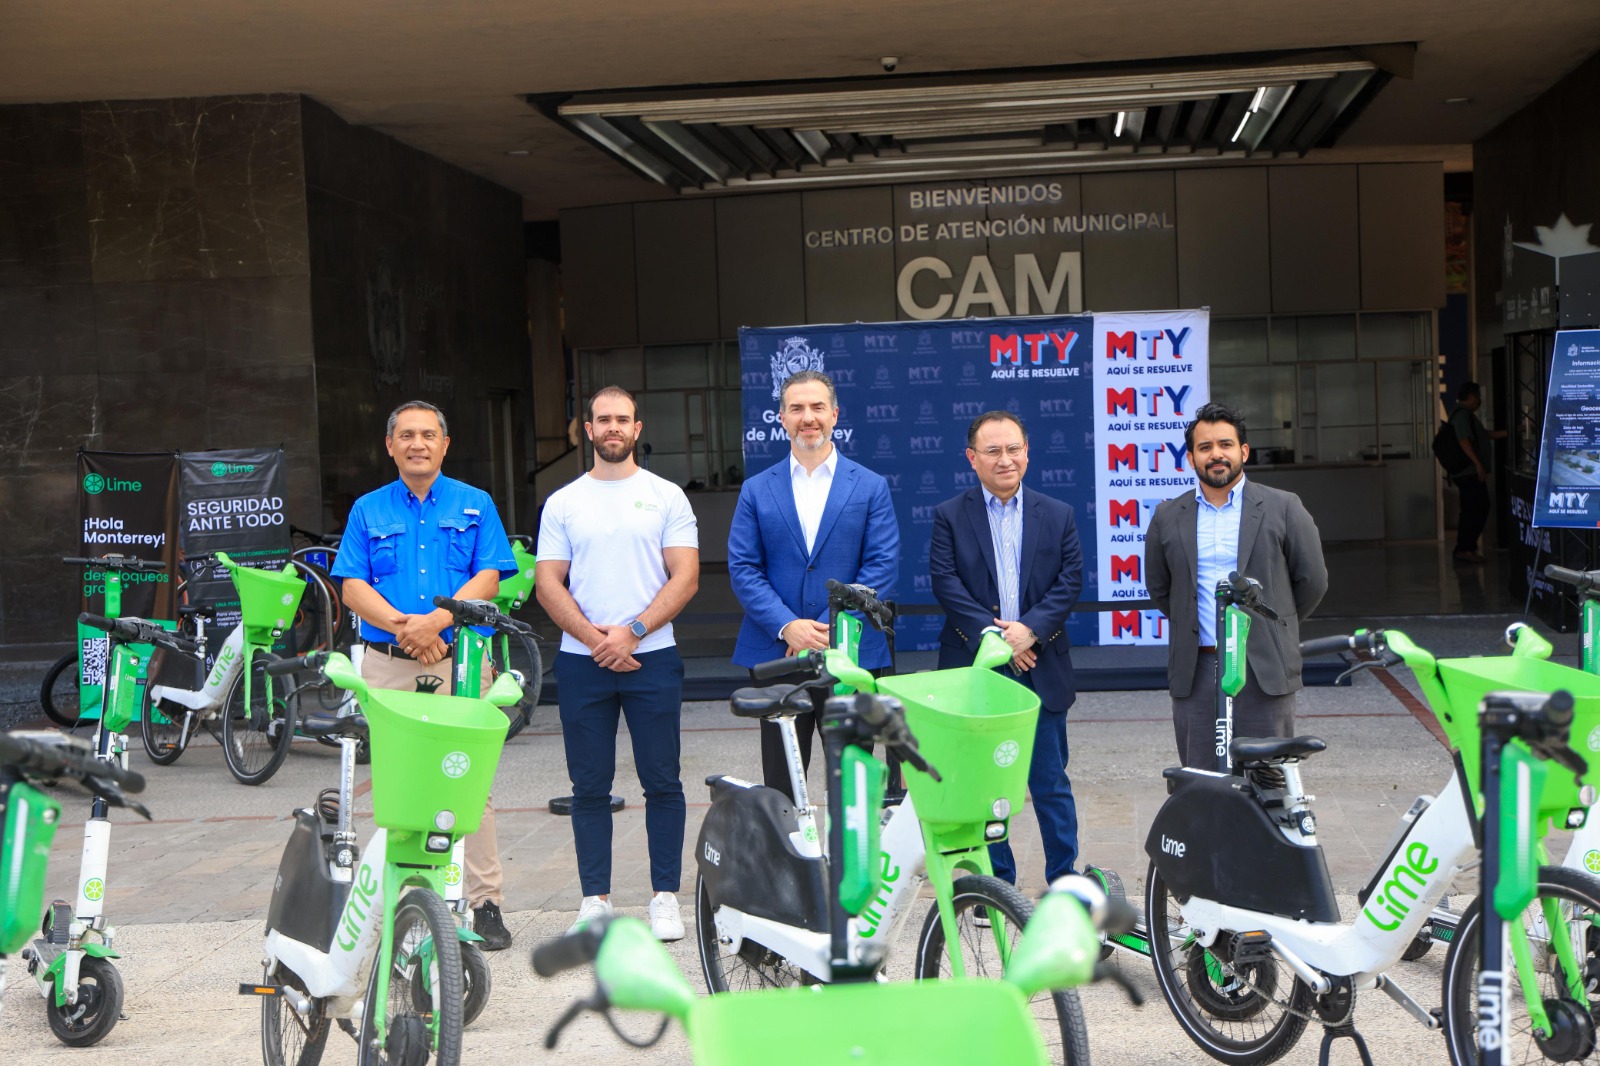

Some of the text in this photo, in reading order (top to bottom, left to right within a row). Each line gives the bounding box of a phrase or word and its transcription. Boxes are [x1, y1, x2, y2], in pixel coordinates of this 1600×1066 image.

[909, 183, 1063, 209] BIENVENIDOS
[805, 212, 1174, 248] CENTRO DE ATENCIÓN MUNICIPAL
[896, 251, 1083, 320] CAM
[864, 335, 898, 348] MTY
[951, 331, 985, 344] MTY
[1106, 327, 1193, 361] MTY
[989, 331, 1080, 366] MTY
[908, 366, 942, 380] MTY
[991, 367, 1080, 379] AQUÍ SE RESUELVE
[1107, 364, 1193, 375] AQUÍ SE RESUELVE
[952, 402, 986, 415] MTY
[1040, 399, 1074, 412] MTY
[1106, 385, 1193, 417] MTY
[867, 405, 899, 418] MTY
[1108, 420, 1131, 431] AQUÍ
[1134, 423, 1145, 431] SE
[746, 428, 766, 441] de
[910, 436, 943, 449] MTY
[1107, 442, 1187, 473] MTY
[227, 463, 255, 474] Lime
[1041, 469, 1075, 481] MTY
[107, 478, 142, 492] Lime
[1109, 476, 1195, 487] AQUÍ SE RESUELVE
[187, 496, 283, 517] SEGURIDAD
[1549, 492, 1590, 508] MTY
[1109, 498, 1173, 528] MT
[84, 517, 124, 532] ¡Hola
[189, 512, 284, 532] ANTE TODO
[84, 532, 166, 548] Monterrey!
[1110, 532, 1134, 543] AQUÍ
[84, 569, 169, 585] desloqueos
[1112, 587, 1135, 598] AQUÍ
[1215, 718, 1228, 757] Lime
[704, 841, 721, 866] Lime
[1161, 834, 1186, 858] Lime
[1363, 841, 1439, 932] Lime
[337, 864, 378, 951] Lime
[1478, 970, 1503, 1051] Lime
